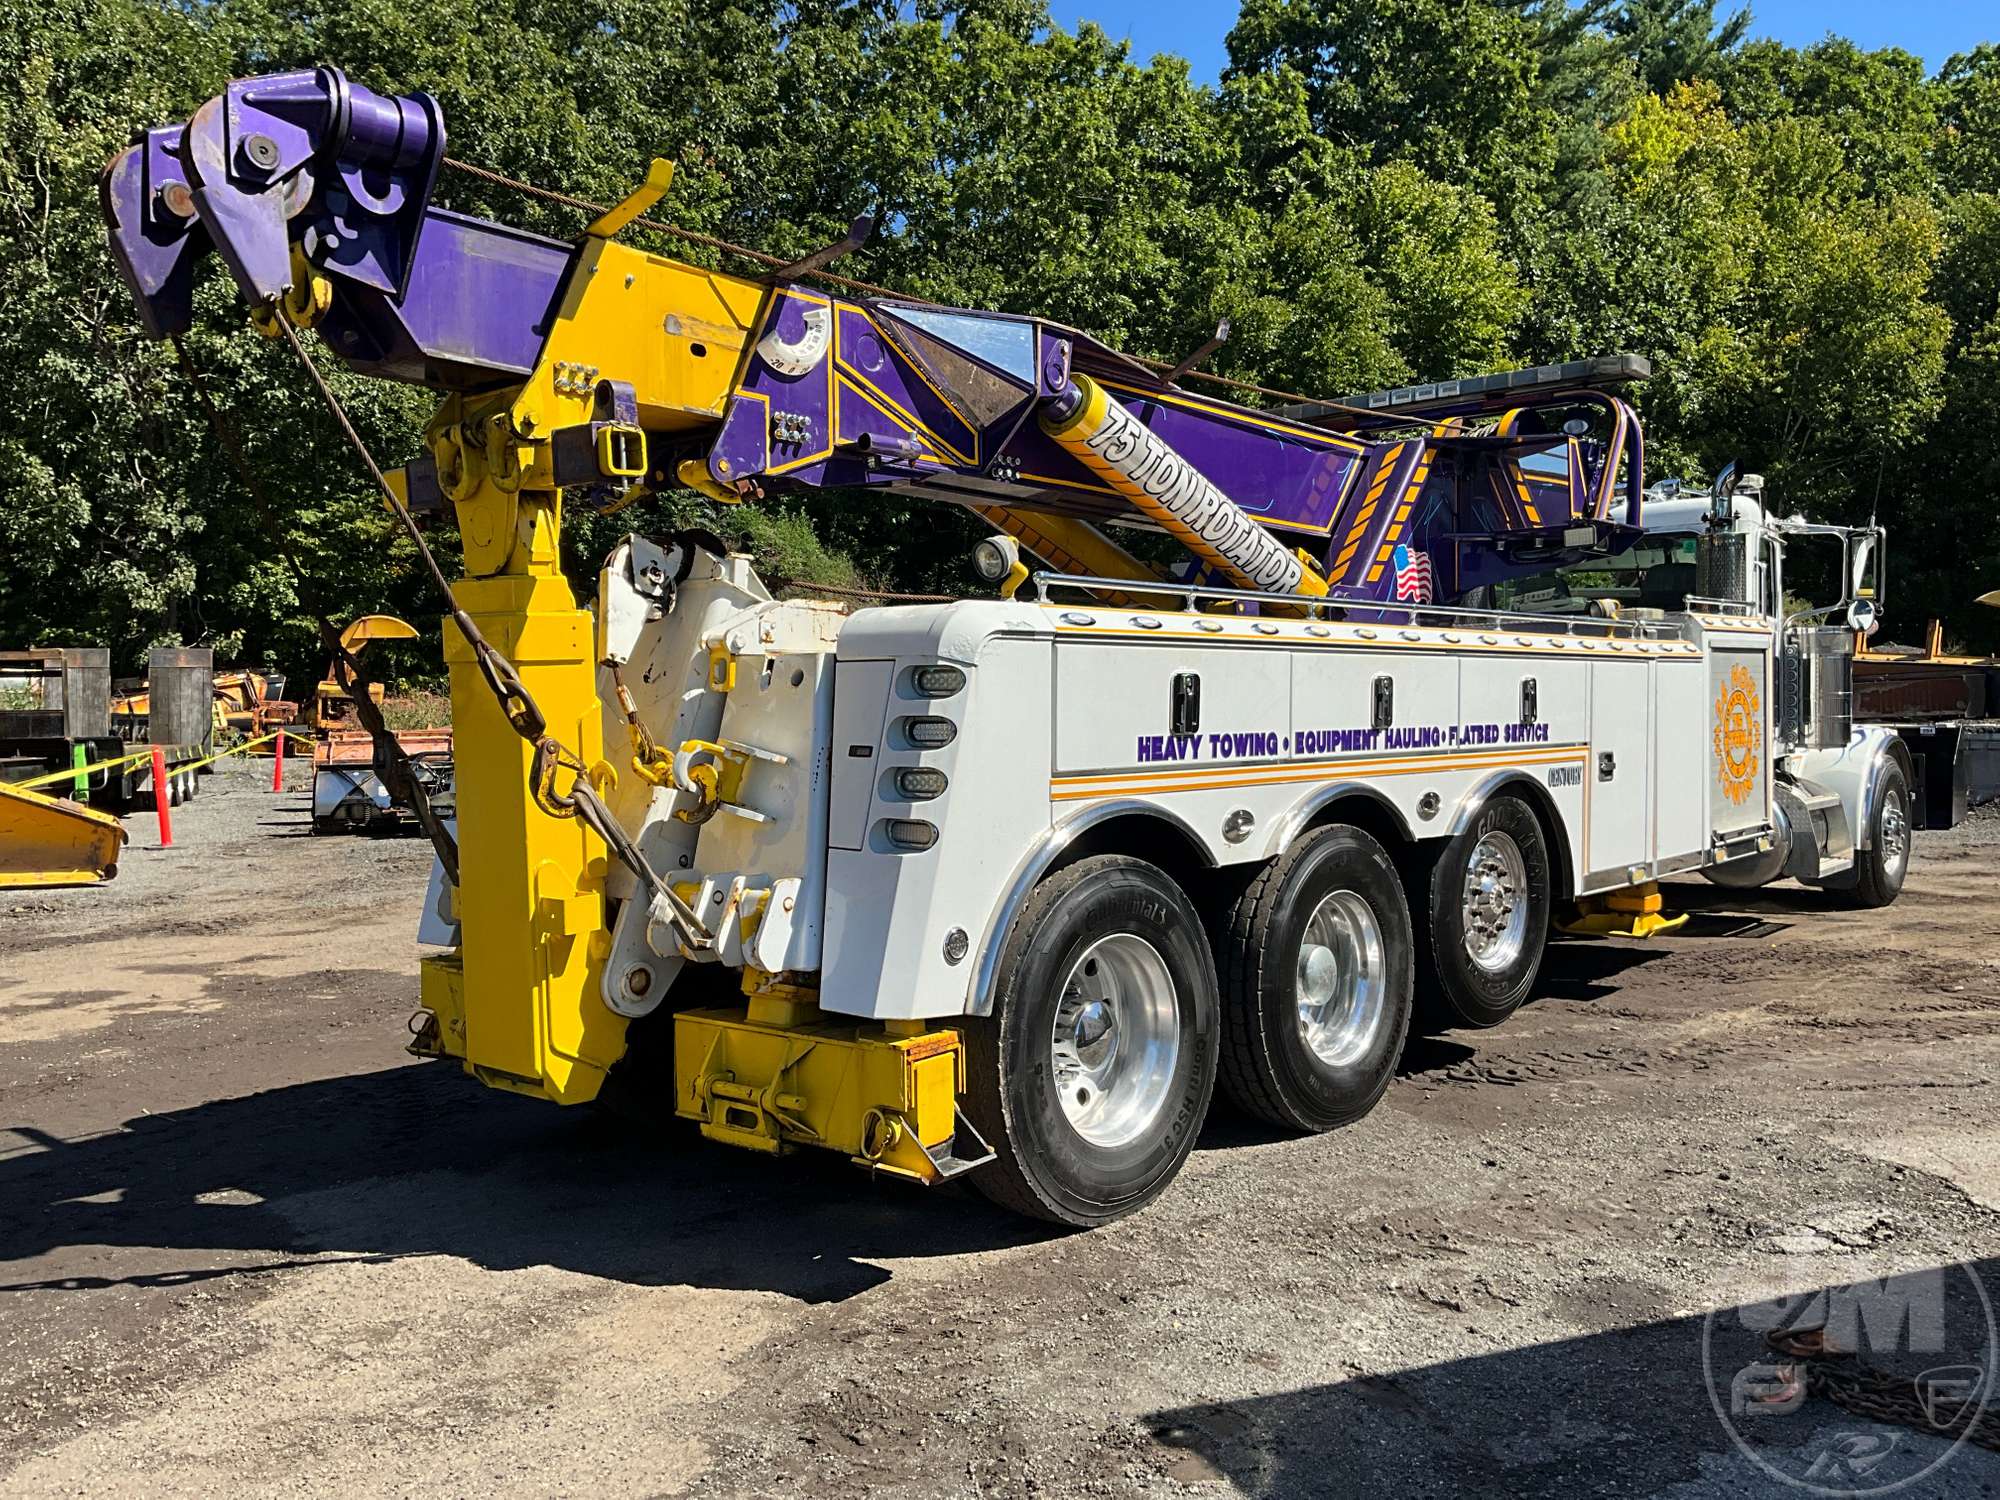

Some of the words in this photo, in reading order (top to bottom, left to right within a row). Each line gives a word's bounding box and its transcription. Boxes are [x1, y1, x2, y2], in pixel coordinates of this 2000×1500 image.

[1086, 402, 1142, 464] 75
[1127, 434, 1199, 513] TON
[1180, 482, 1303, 595] ROTATOR
[1137, 734, 1203, 763] HEAVY
[1209, 731, 1278, 759] TOWING
[1294, 728, 1380, 755] EQUIPMENT
[1384, 726, 1441, 750] HAULING
[1503, 723, 1549, 743] SERVICE
